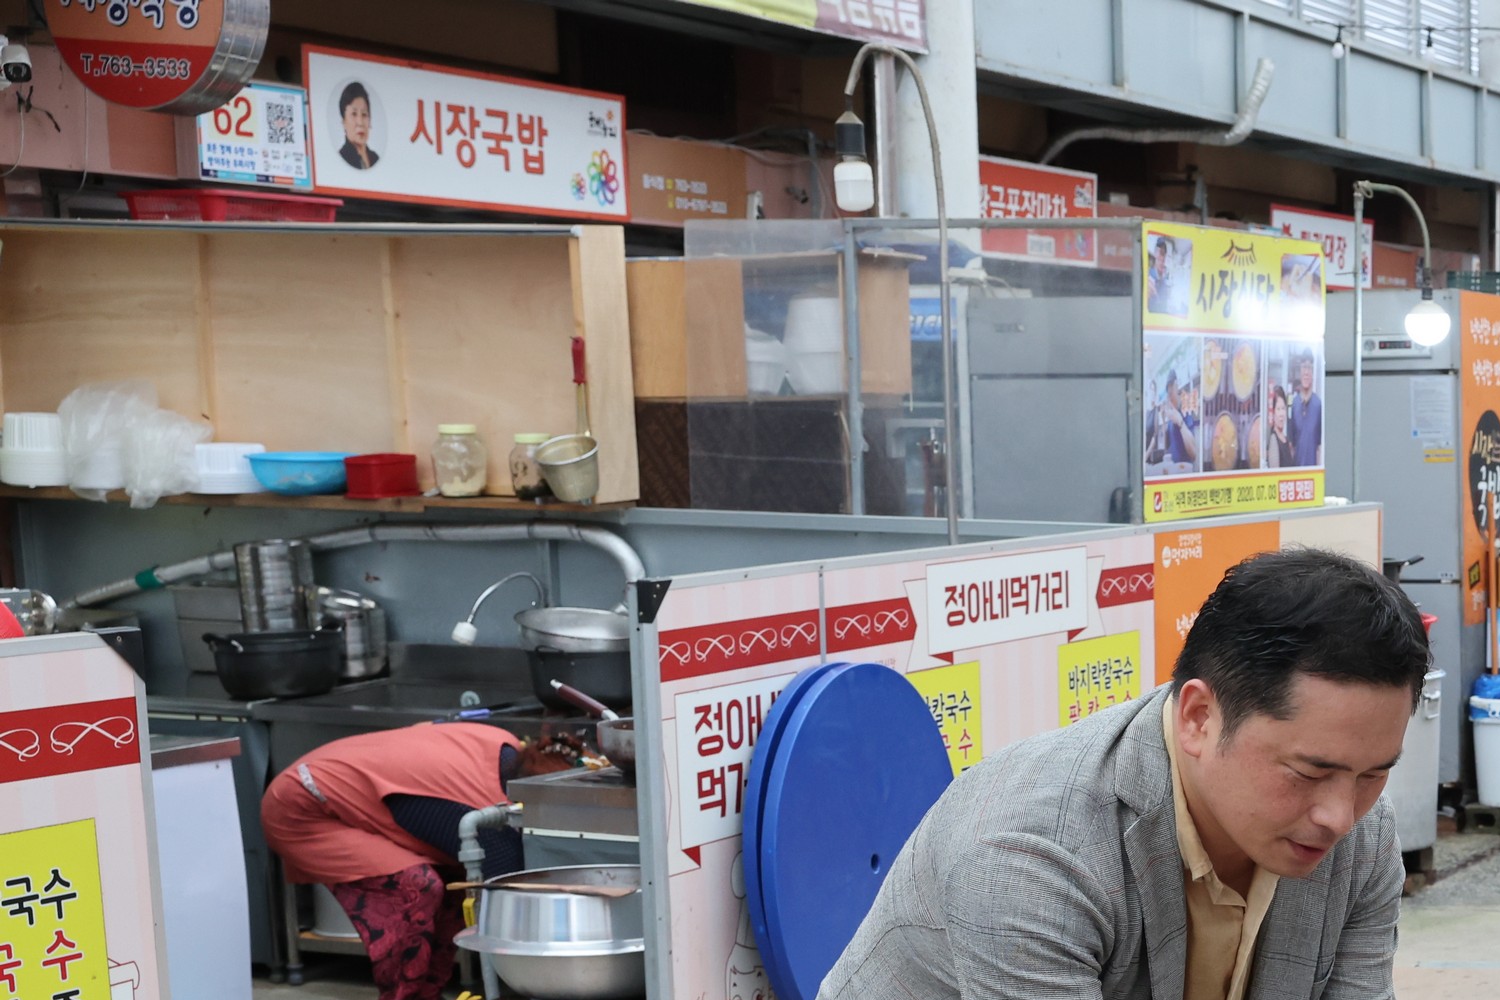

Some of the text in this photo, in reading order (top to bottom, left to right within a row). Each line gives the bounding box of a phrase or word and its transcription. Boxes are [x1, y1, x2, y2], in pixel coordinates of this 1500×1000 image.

[80, 53, 191, 79] T.763-3533
[213, 95, 254, 138] 62
[410, 98, 549, 176] 시장국밥
[944, 569, 1069, 627] 정아네먹거리
[1068, 655, 1133, 698] 바지락칼국수
